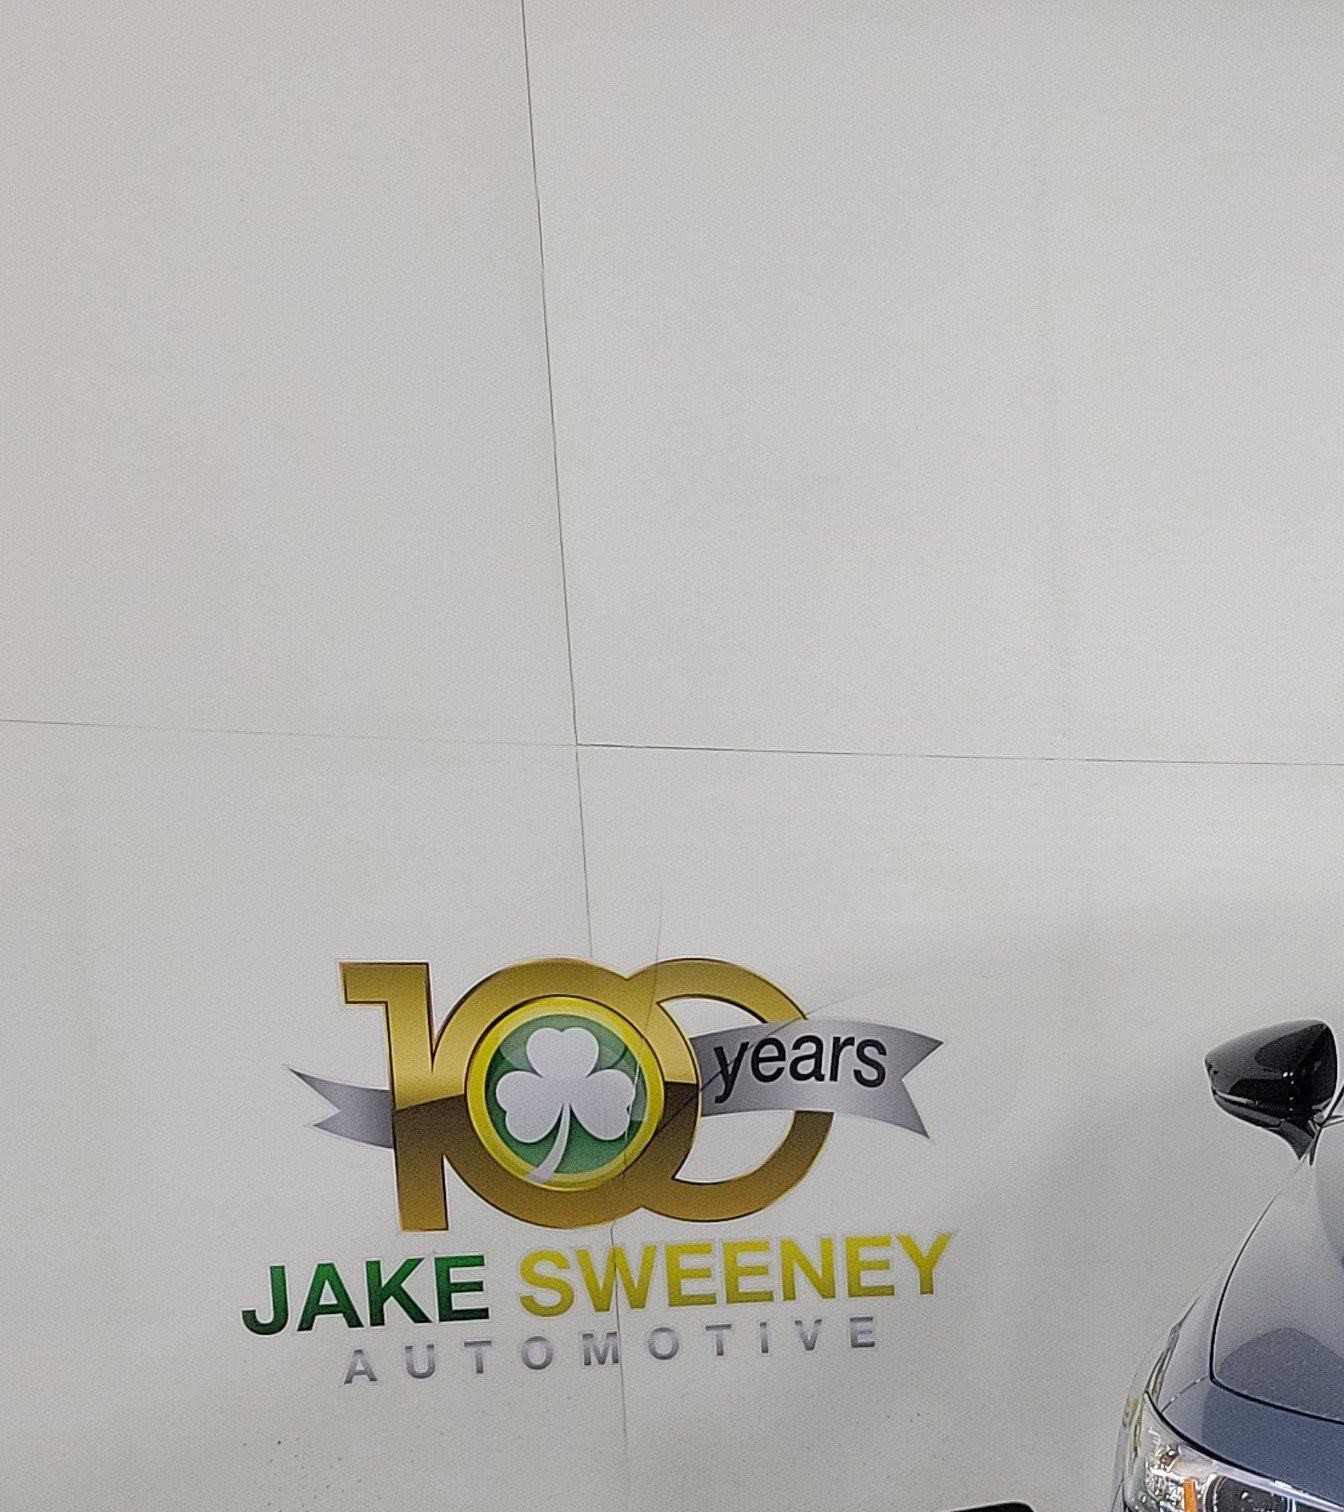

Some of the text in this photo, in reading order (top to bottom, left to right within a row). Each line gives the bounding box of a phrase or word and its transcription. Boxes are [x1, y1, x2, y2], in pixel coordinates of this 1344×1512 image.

[339, 957, 889, 1232] 100 years
[242, 1233, 953, 1336] JAKE SWEENEY
[343, 1316, 877, 1385] AUTOMOTIVE
